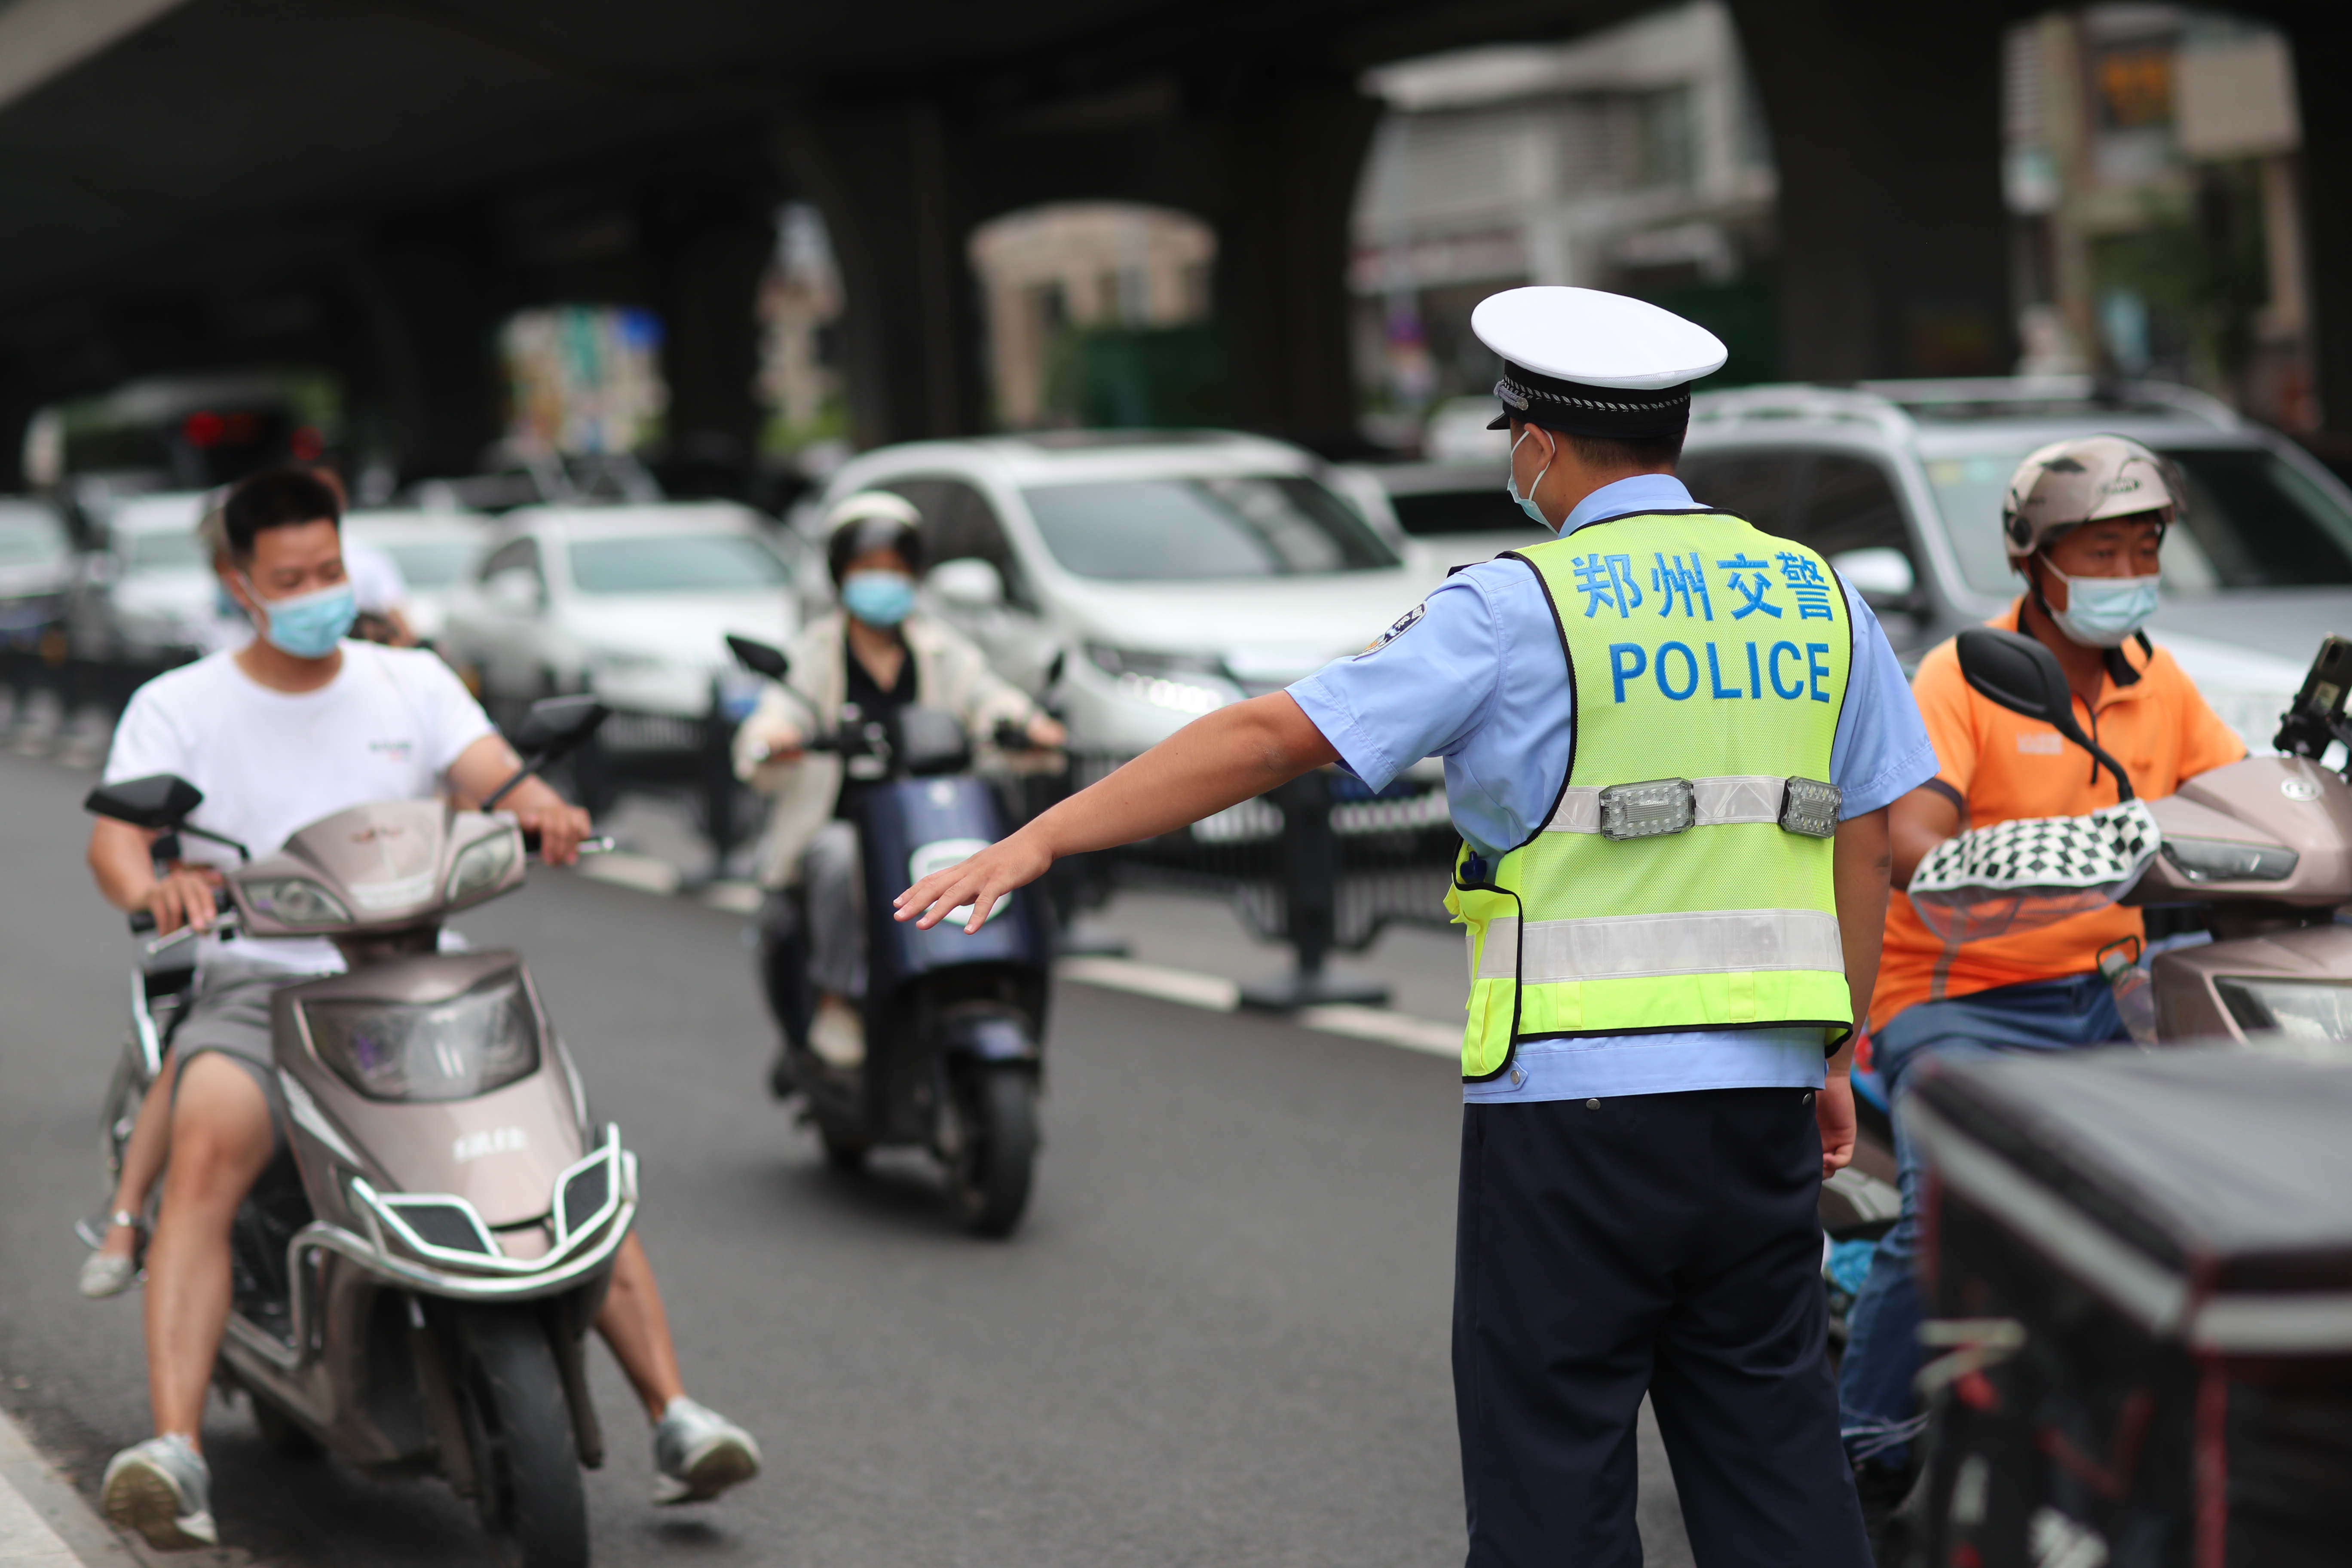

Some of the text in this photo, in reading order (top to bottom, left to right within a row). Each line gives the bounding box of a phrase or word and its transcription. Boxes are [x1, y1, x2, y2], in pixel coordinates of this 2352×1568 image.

[1572, 551, 1833, 622] 郑州交警
[1609, 640, 1830, 703] POLICE
